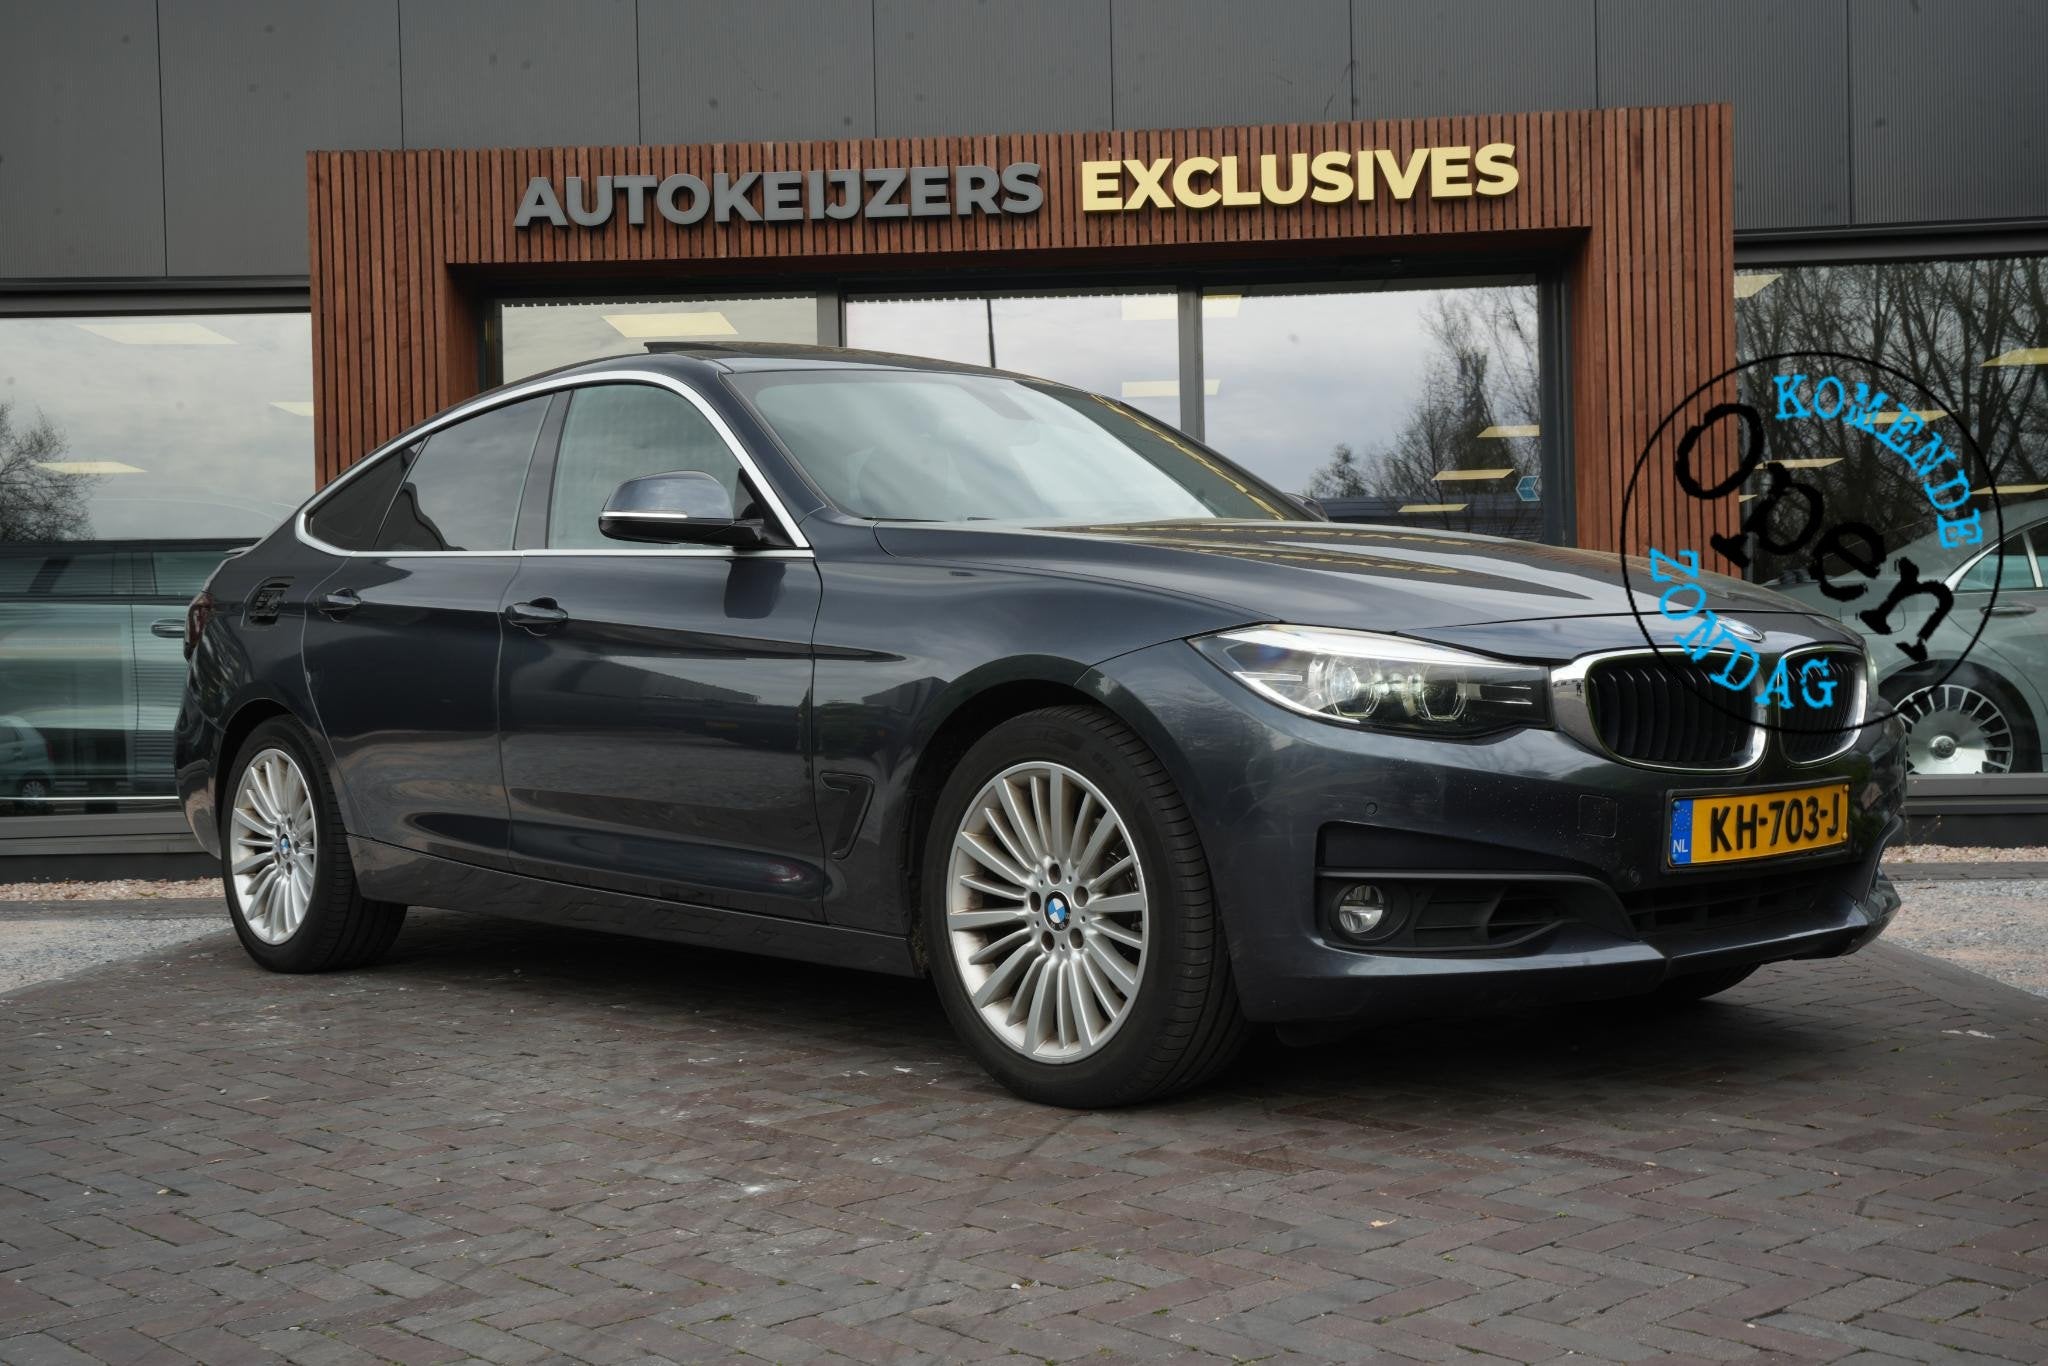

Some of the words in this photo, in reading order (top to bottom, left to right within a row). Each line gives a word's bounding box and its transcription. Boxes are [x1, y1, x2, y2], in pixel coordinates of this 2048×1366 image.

[513, 161, 1044, 228] AUTOKEIJZERS
[1081, 143, 1520, 213] EXCLUSIVES
[1672, 838, 1689, 853] NL
[1710, 792, 1840, 854] KH-703-J
